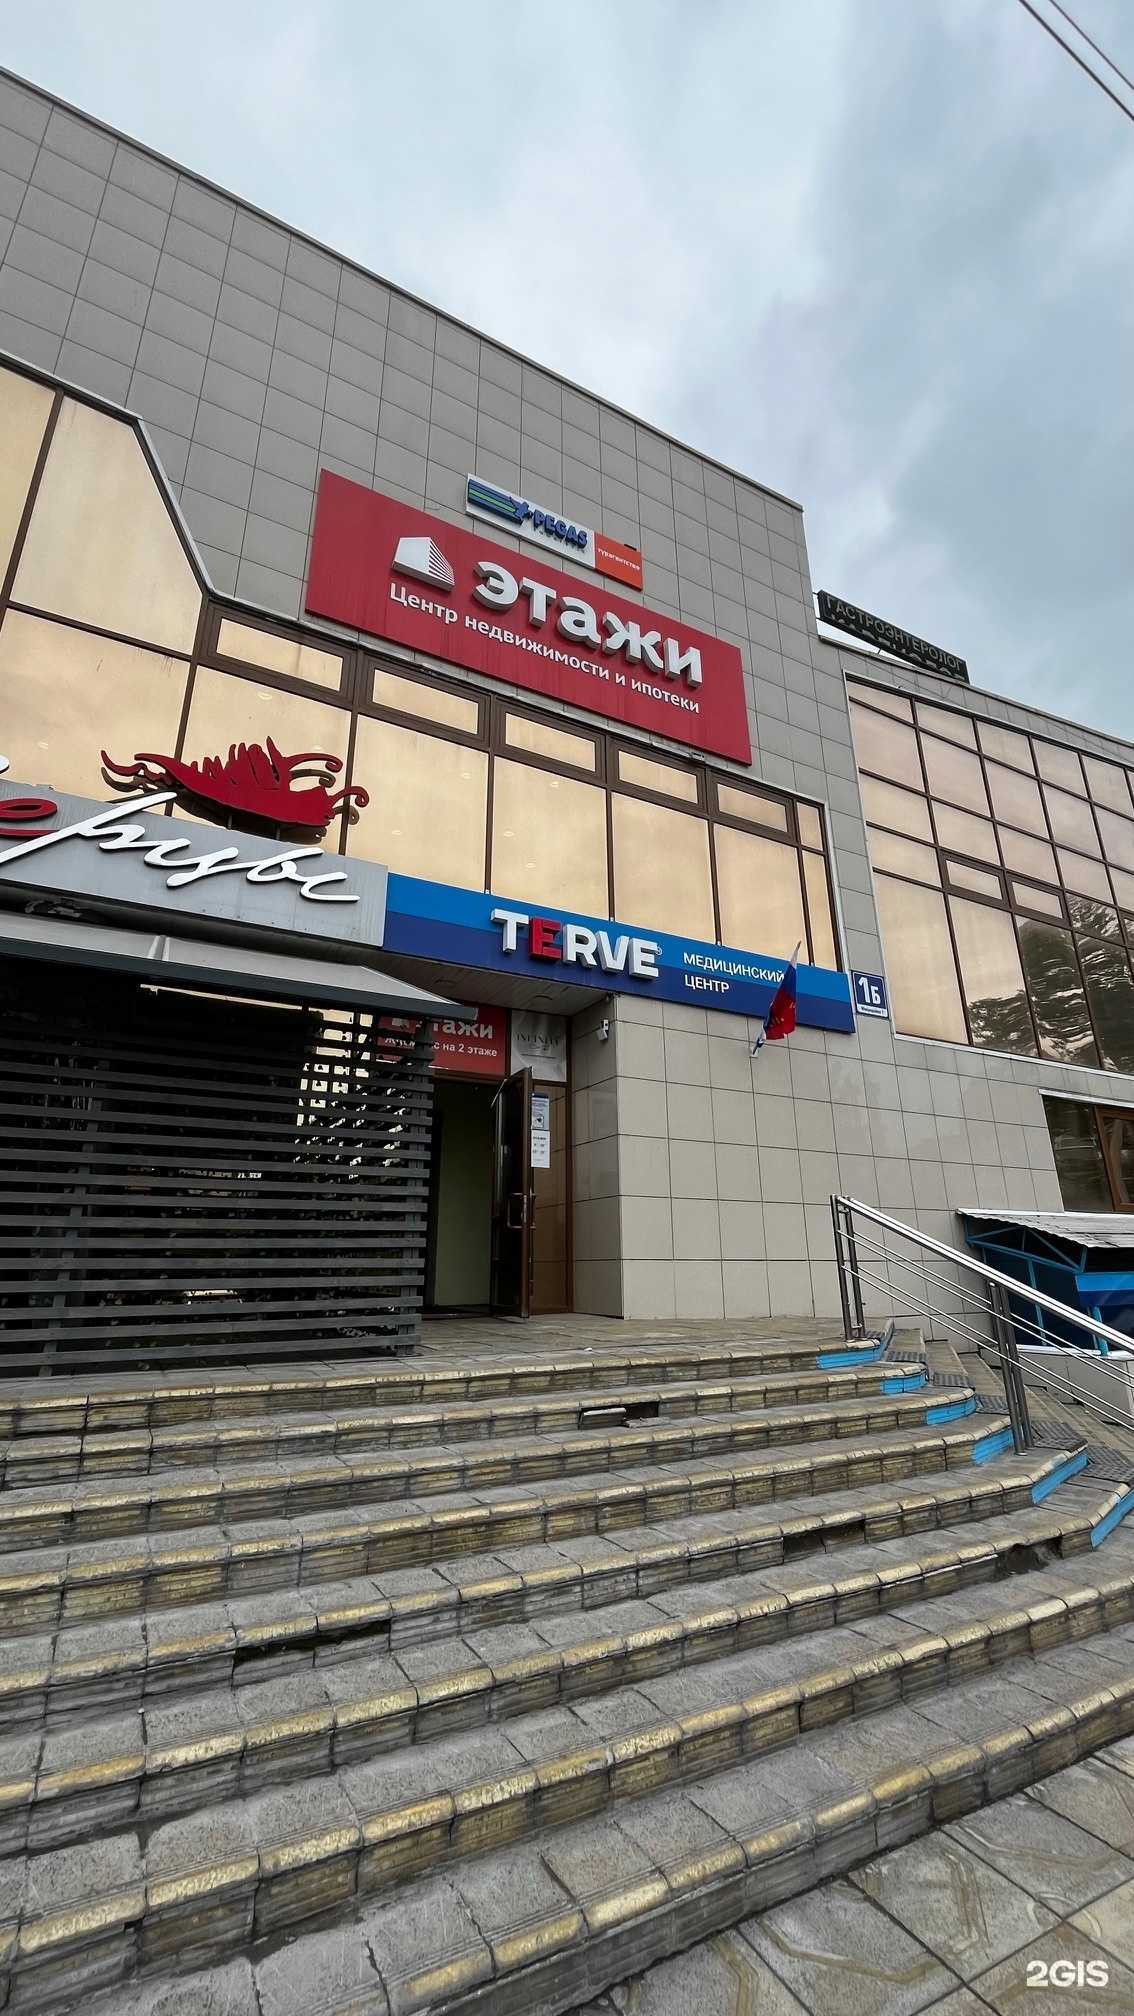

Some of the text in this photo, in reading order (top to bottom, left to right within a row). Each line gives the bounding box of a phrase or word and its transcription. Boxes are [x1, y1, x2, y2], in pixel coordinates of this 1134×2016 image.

[532, 508, 588, 549] PEGAS
[390, 582, 700, 713] Центр недвижимости и ипотеки
[490, 908, 660, 980] TERVE
[683, 952, 785, 983] МЕДИЦИНСКИЙ
[684, 974, 730, 993] ЦЕНТР
[442, 1043, 456, 1052] на
[458, 1043, 465, 1052] 2
[467, 1046, 498, 1057] этаже
